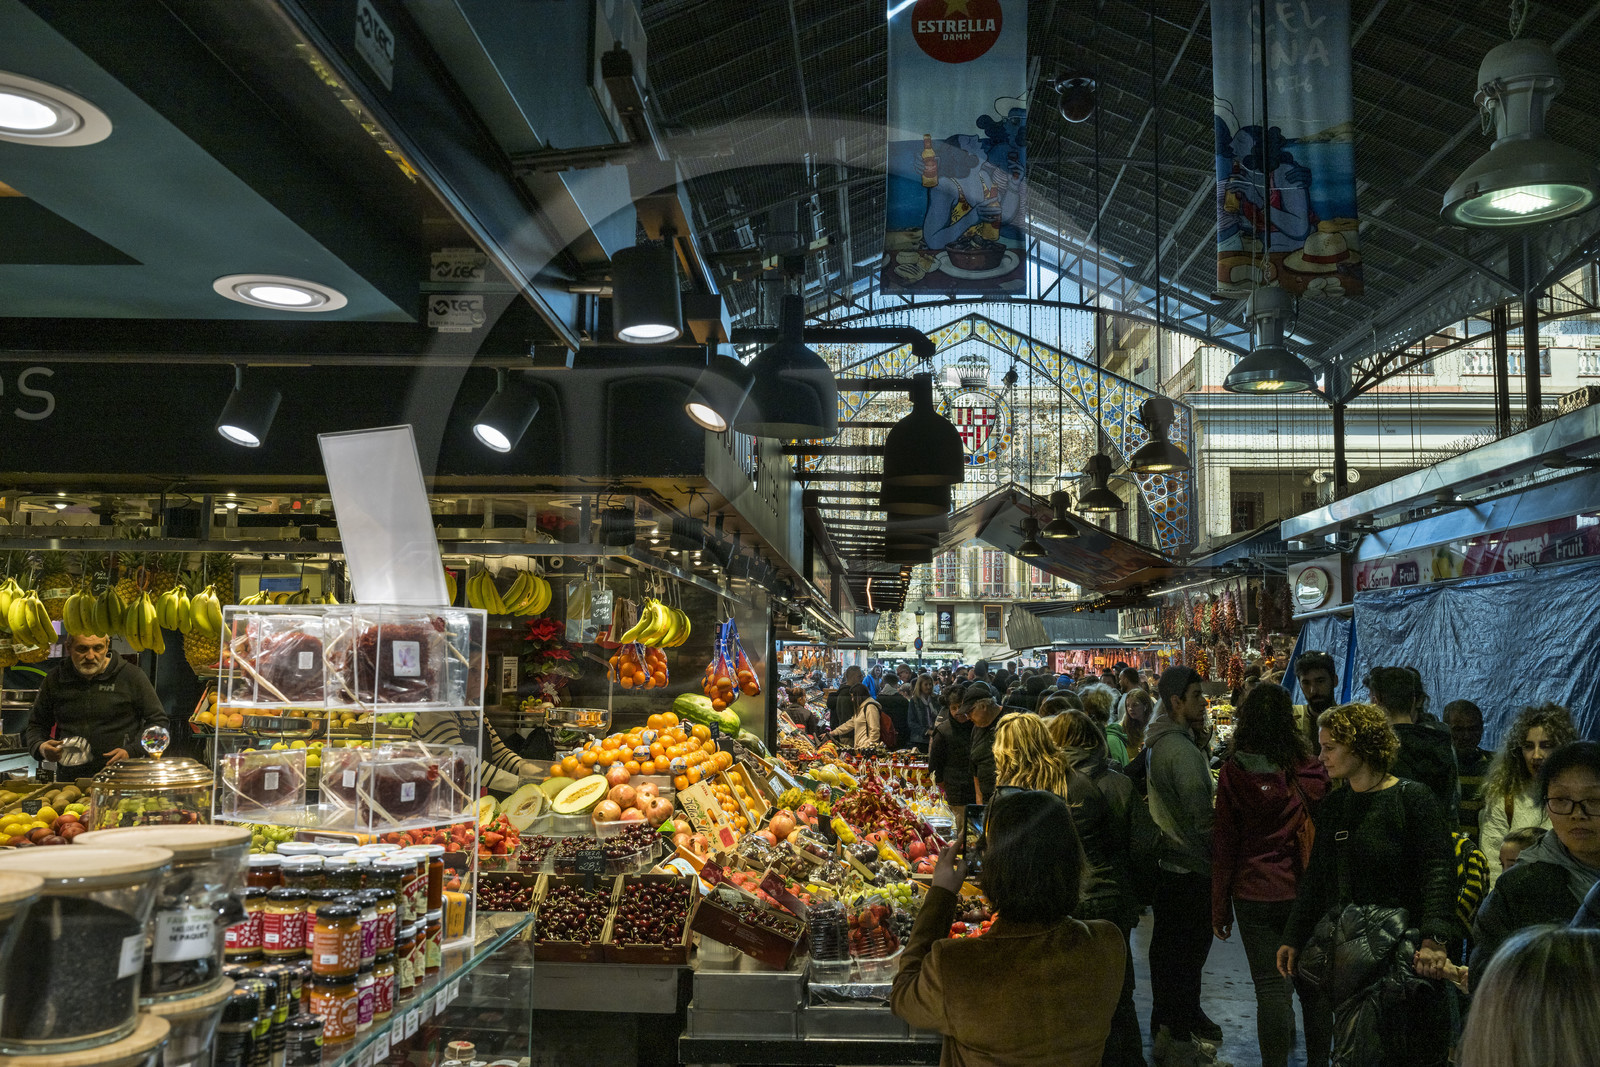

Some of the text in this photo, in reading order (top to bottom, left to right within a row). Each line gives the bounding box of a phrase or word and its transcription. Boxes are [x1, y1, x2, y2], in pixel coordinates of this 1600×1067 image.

[917, 19, 996, 33] ESTRELLA
[942, 33, 971, 41] DAMM
[0, 366, 56, 421] s
[1507, 537, 1584, 567] Sprim Fruit
[1370, 568, 1417, 588] Sprim Fruit
